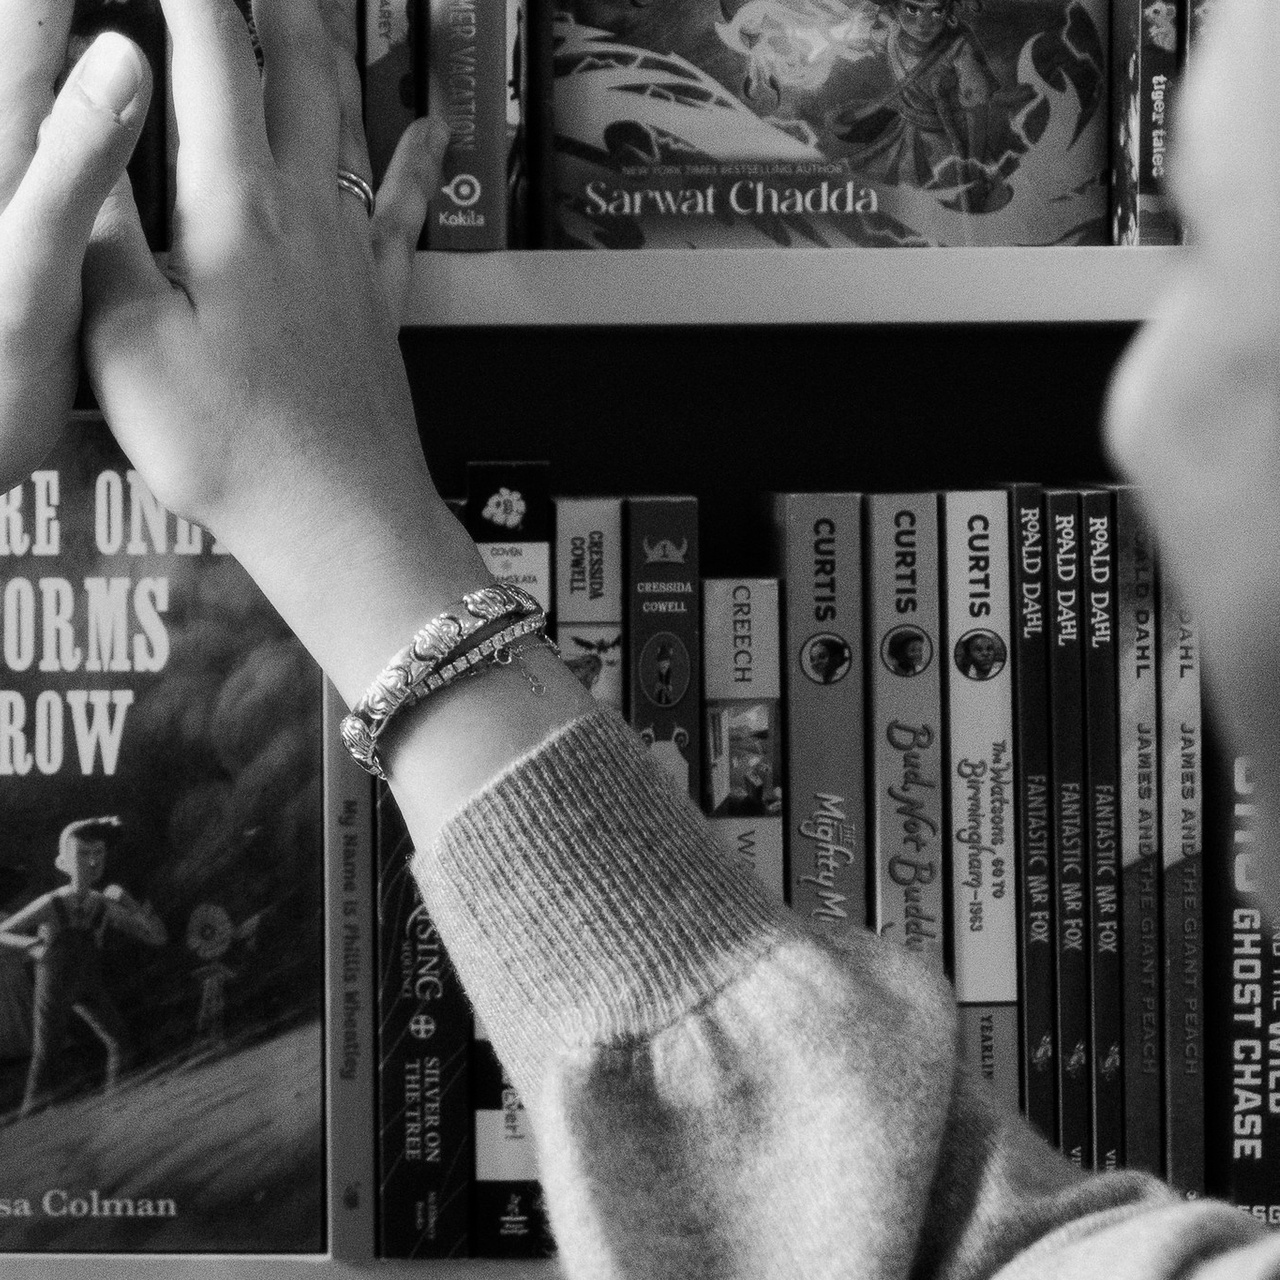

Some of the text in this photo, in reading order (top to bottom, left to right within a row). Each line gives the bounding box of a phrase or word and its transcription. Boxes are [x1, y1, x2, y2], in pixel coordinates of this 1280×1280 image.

[439, 211, 485, 226] Kokila
[585, 180, 878, 215] Sarwat Chadda
[570, 536, 586, 595] COWELL
[589, 530, 604, 600] CRESSIDA
[637, 582, 693, 594] CRESSIDA
[643, 602, 688, 612] COWELL
[813, 518, 837, 621] CURTIS
[894, 510, 917, 614] CURTIS
[967, 514, 991, 618] CURTIS
[1021, 508, 1042, 639] ROALD DAHL
[1056, 515, 1077, 646] ROALD DAHL
[1089, 517, 1111, 648] ROALD DAHL
[732, 585, 753, 684] CREECH
[1137, 723, 1152, 800] JAMES
[1180, 723, 1195, 800] JAMES
[342, 834, 359, 892] Name
[1027, 774, 1050, 943] FANTASTIC MR FOX
[1061, 782, 1083, 951] FANTASTIC MR FOX
[1095, 785, 1118, 953] FANTASTIC MR FOX
[342, 923, 359, 983] Phillis
[1233, 908, 1262, 1159] GHOST CHASE
[405, 1059, 422, 1161] THE TREE
[423, 1056, 441, 1162] SILVER ON
[42, 1191, 177, 1218] Colman
